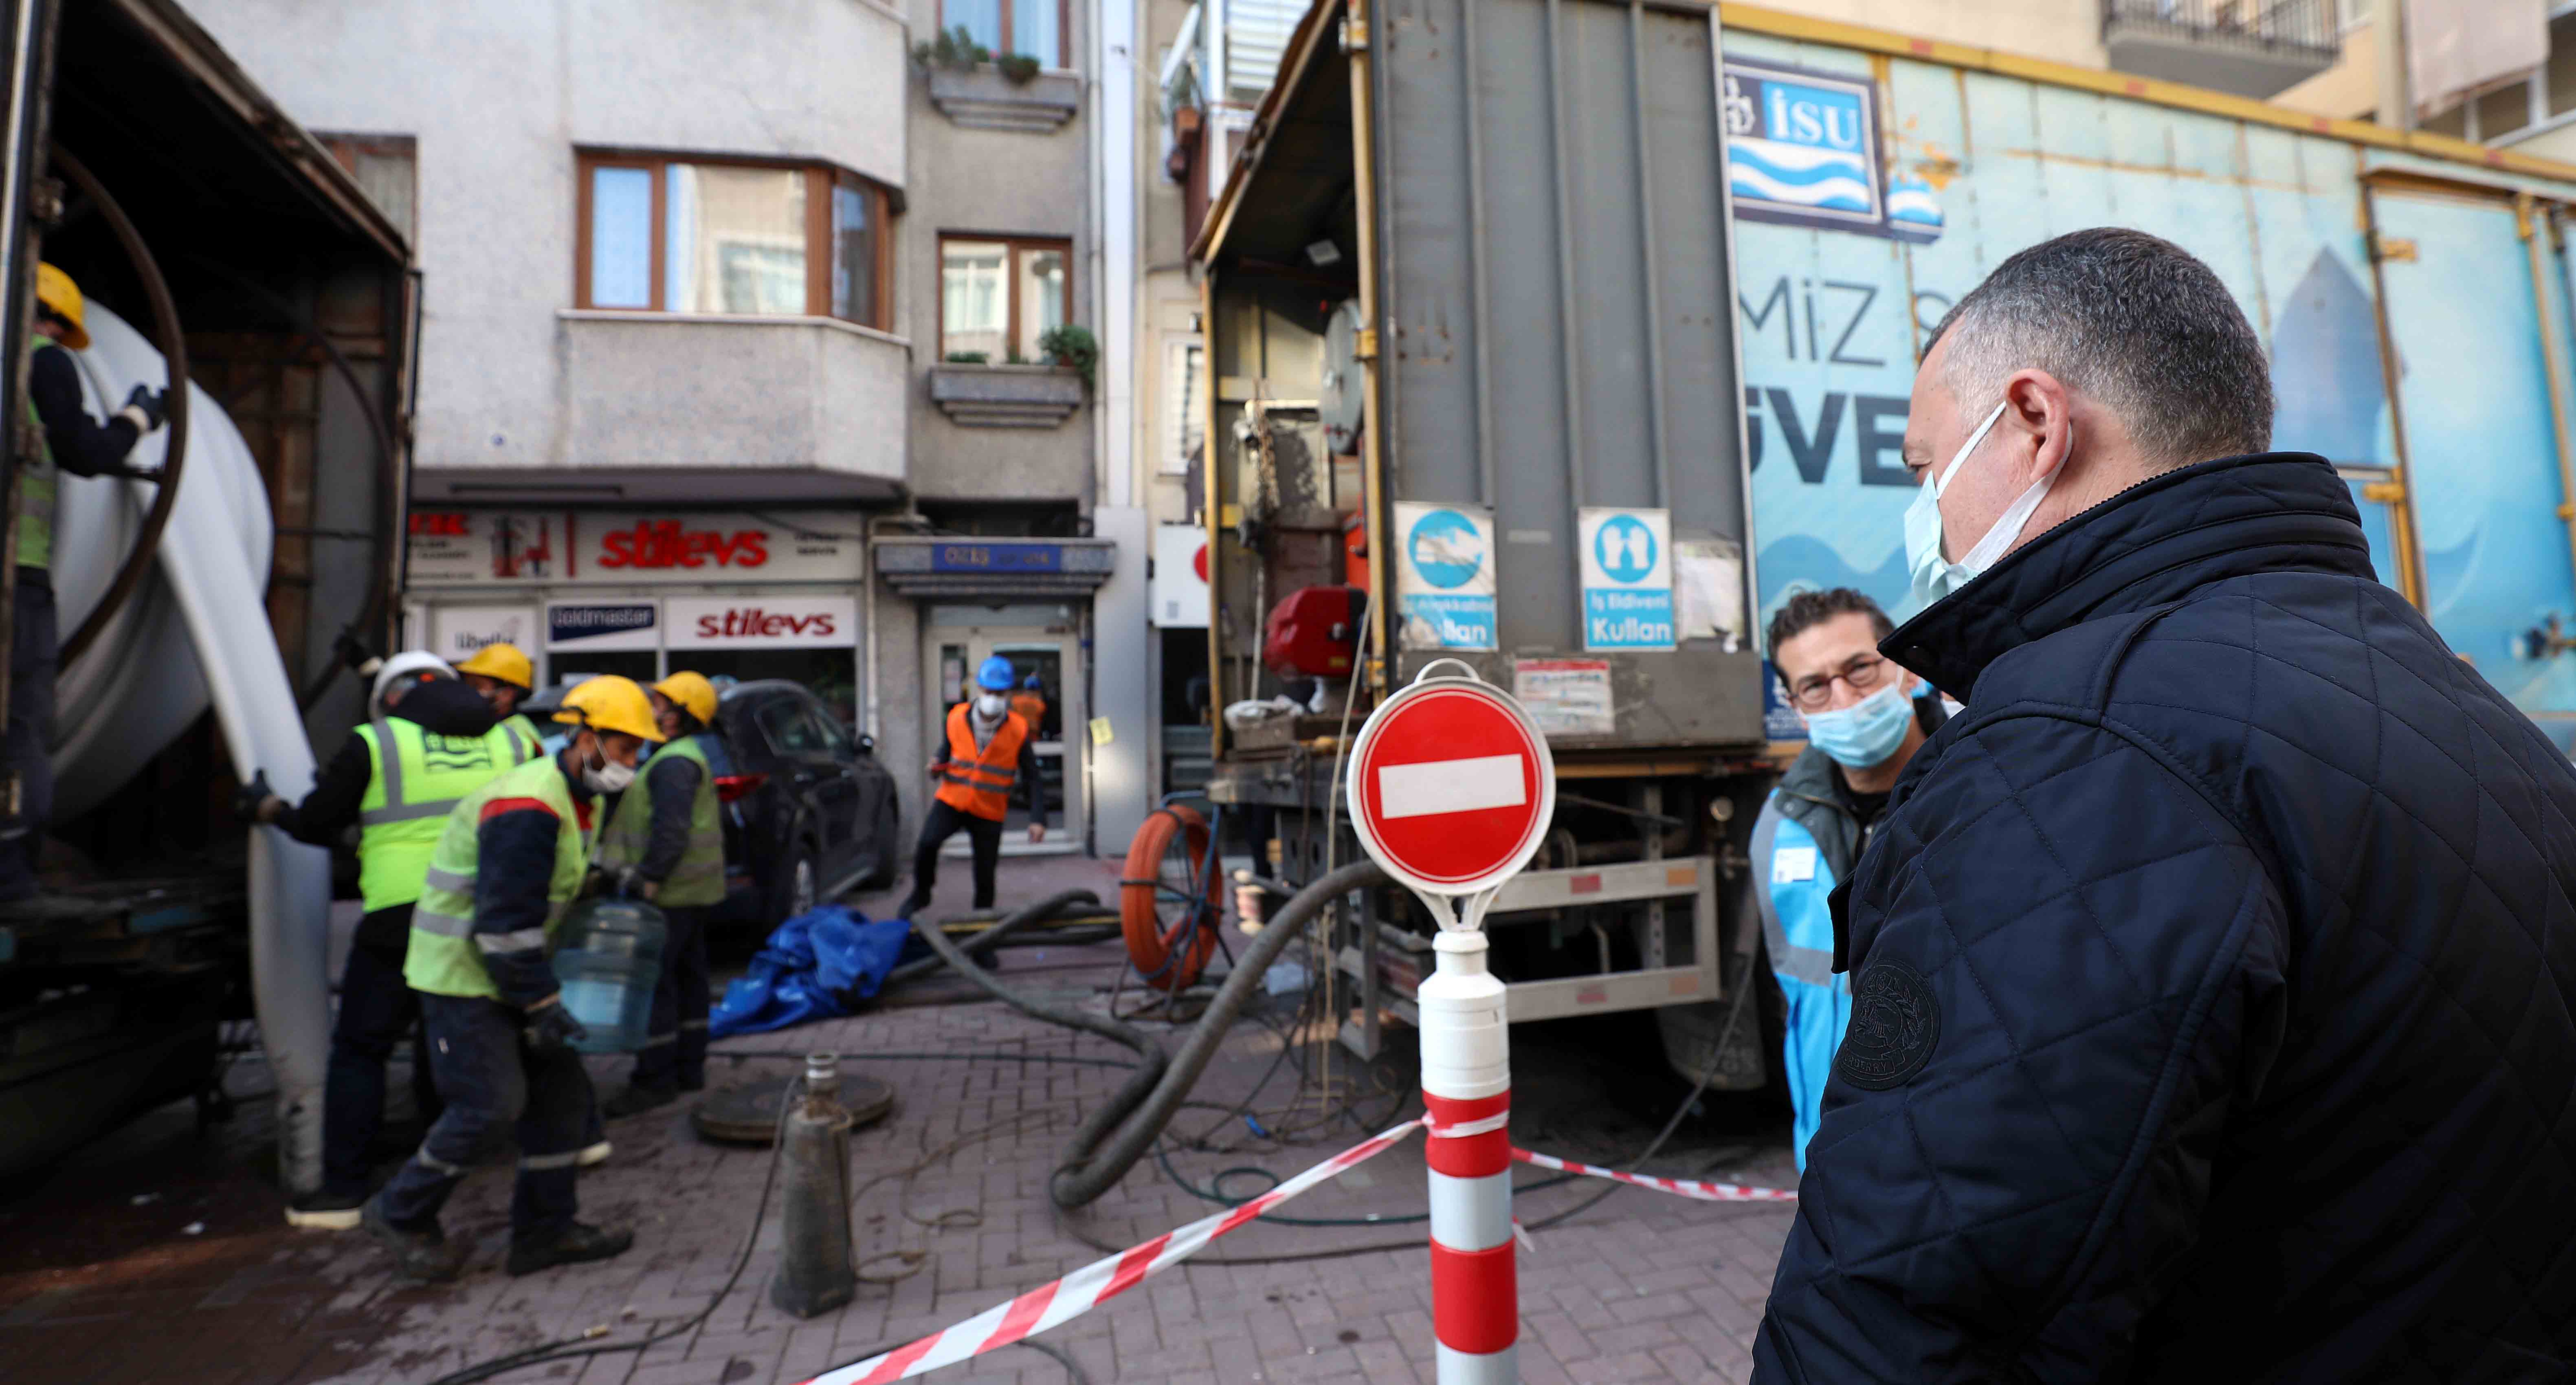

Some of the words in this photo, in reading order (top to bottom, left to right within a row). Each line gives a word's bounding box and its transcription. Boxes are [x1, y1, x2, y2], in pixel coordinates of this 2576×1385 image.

[1745, 385, 1919, 488] VE
[596, 518, 771, 569] stilevs
[697, 607, 835, 638] stilevs
[1593, 616, 1671, 642] Kullan
